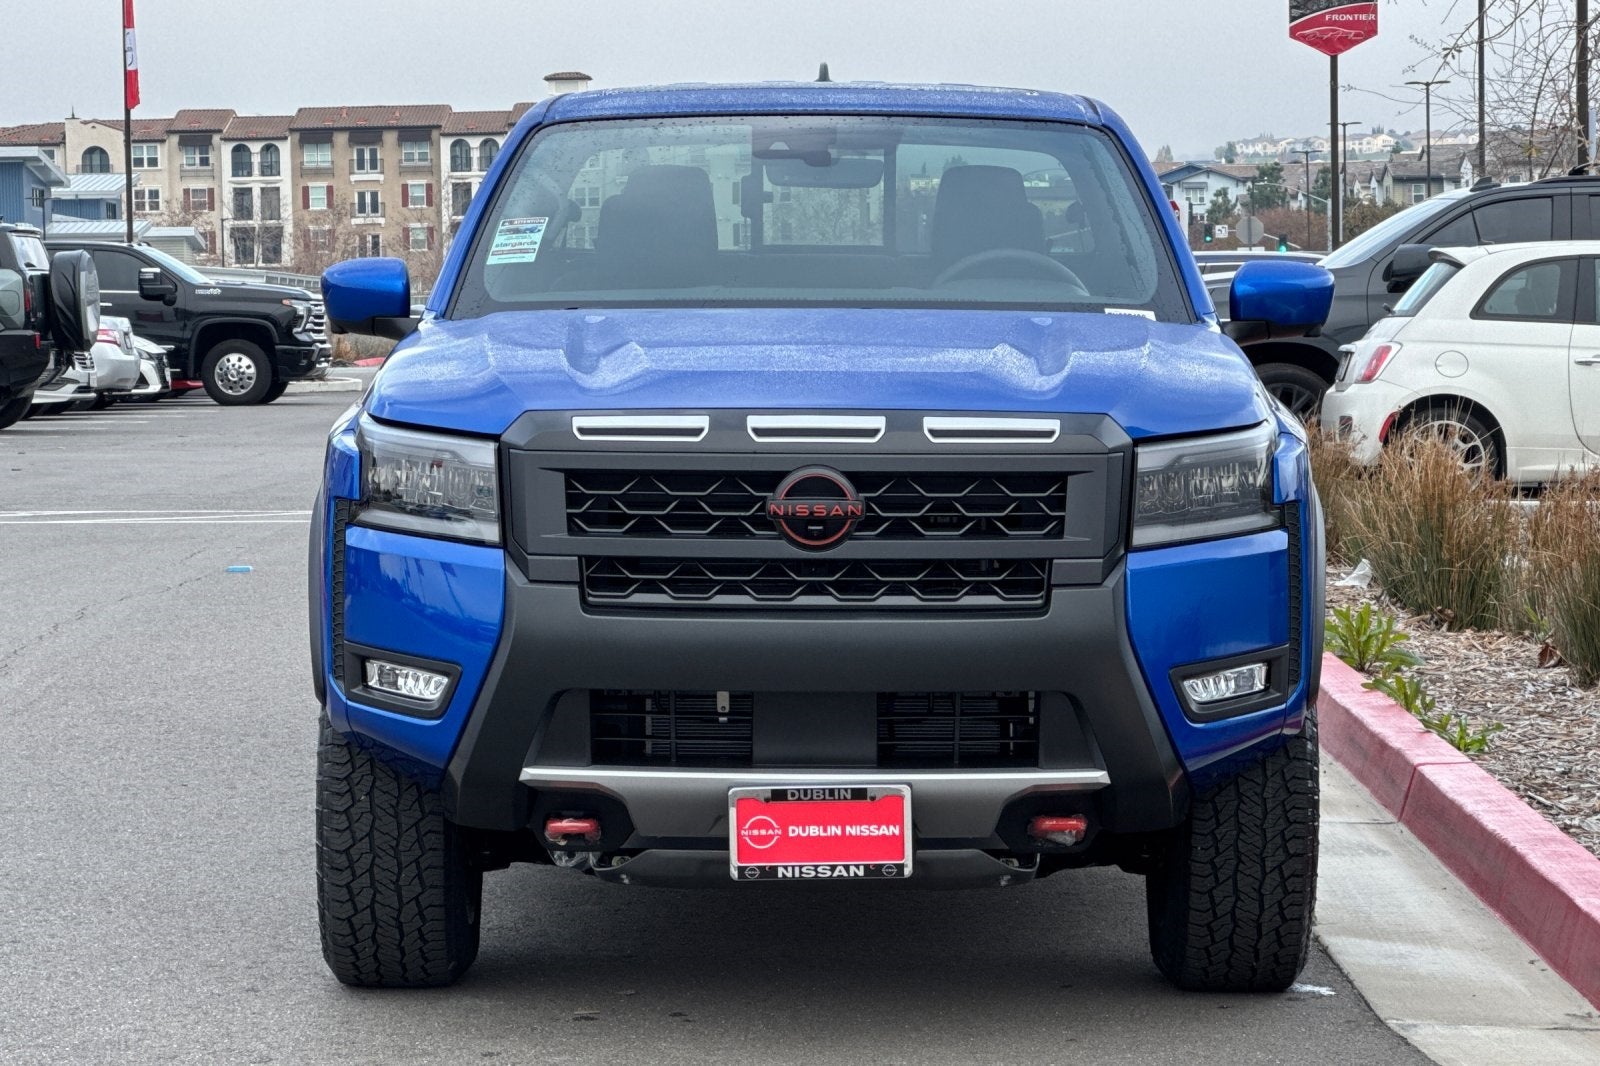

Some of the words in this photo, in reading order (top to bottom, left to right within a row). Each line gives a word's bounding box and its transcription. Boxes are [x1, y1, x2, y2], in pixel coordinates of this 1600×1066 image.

[769, 503, 862, 517] NISSAN
[787, 788, 852, 801] DUBLIN
[788, 825, 842, 837] DUBLIN
[845, 825, 900, 837] NISSAN
[777, 865, 865, 878] NISSAN
